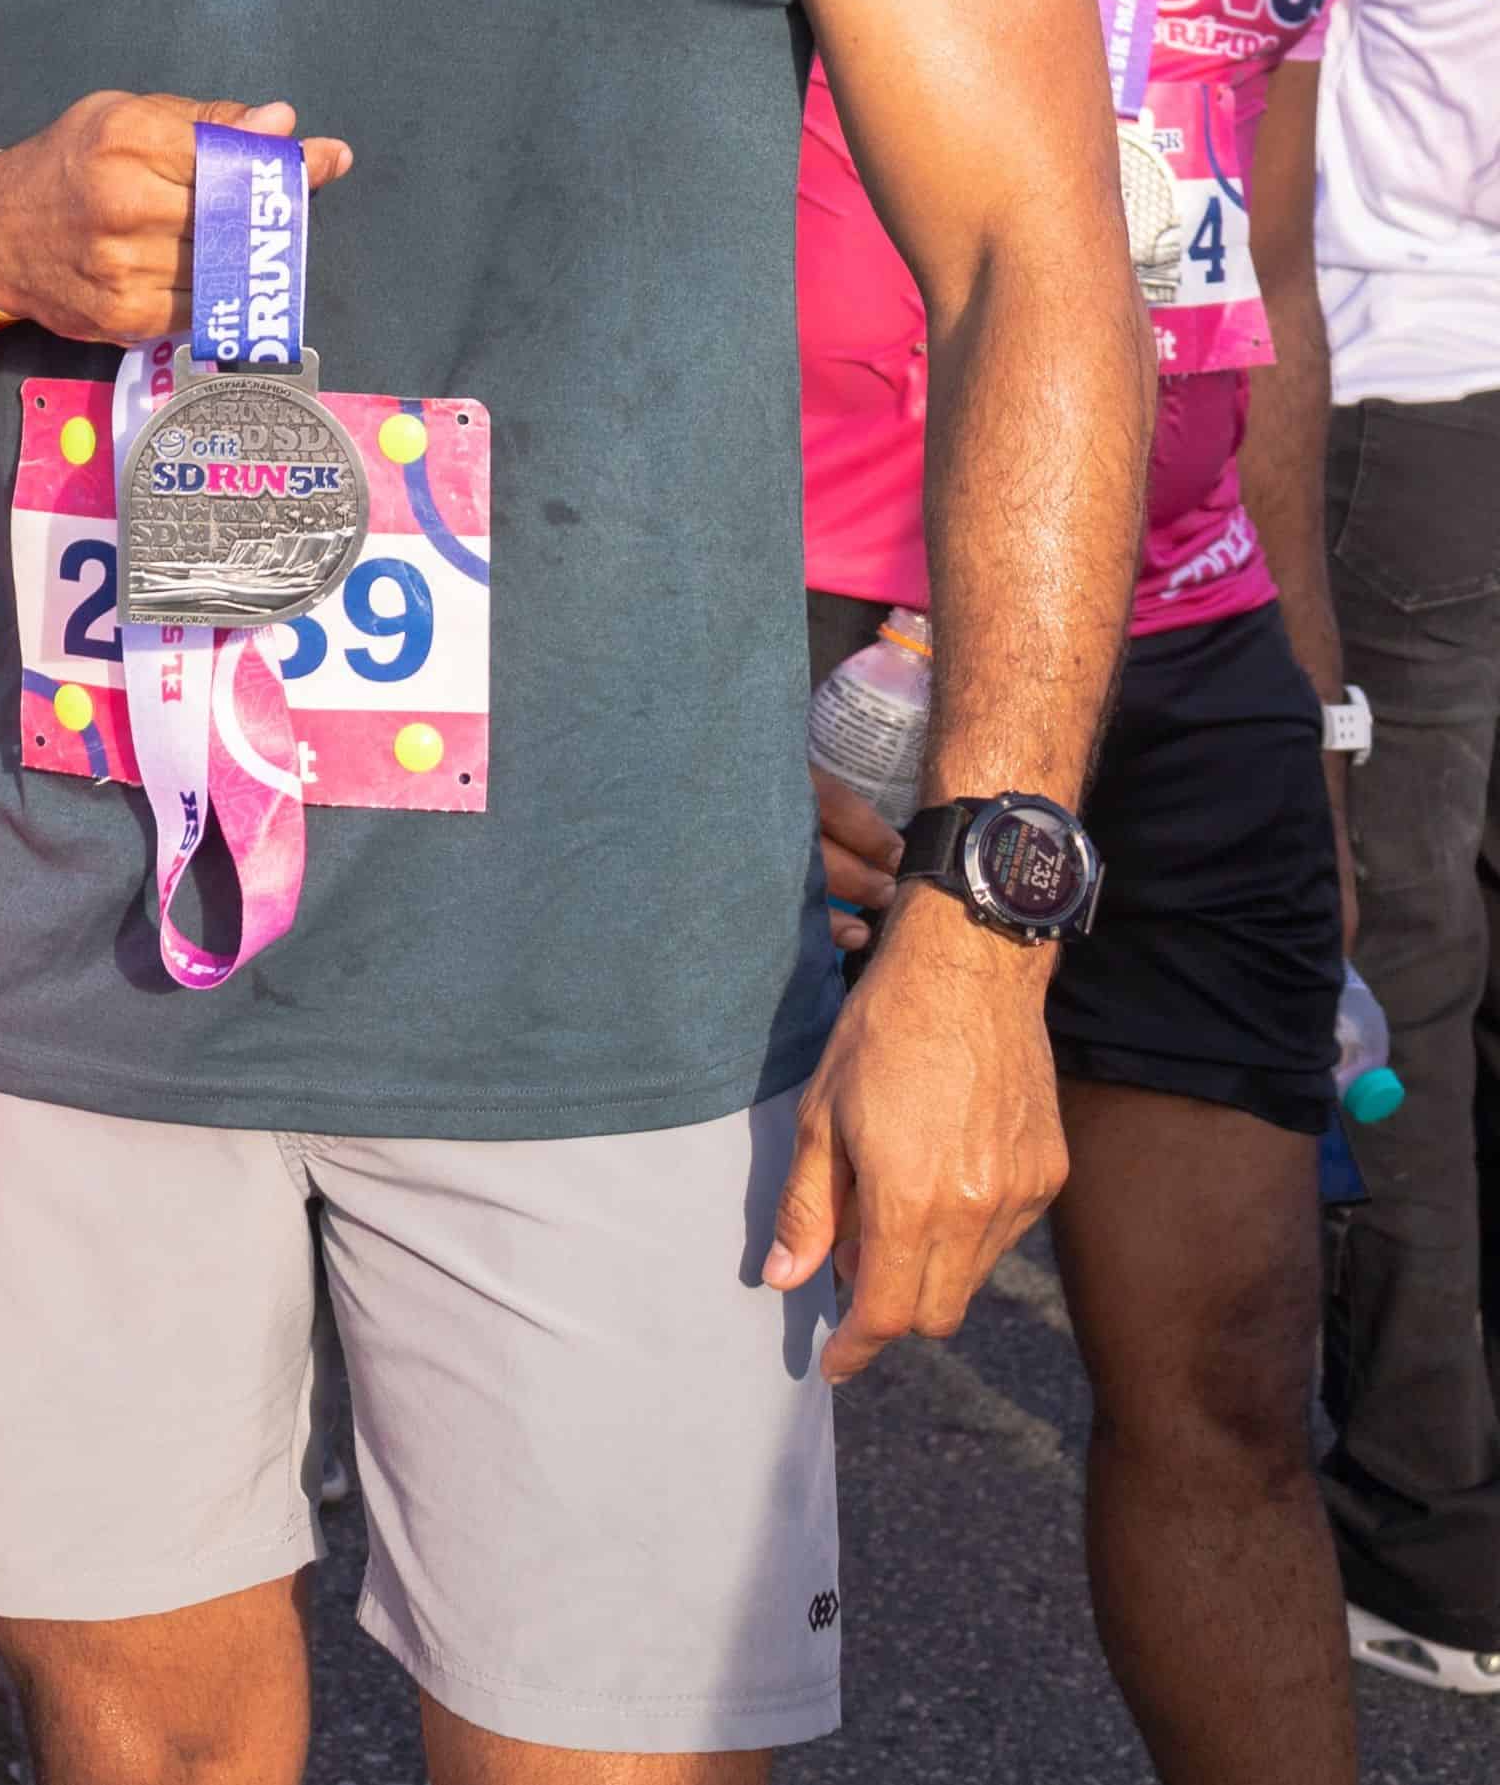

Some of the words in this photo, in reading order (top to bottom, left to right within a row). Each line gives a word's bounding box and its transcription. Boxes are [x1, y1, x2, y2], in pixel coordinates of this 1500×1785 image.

[206, 296, 241, 361] ofit
[192, 435, 240, 457] ofit
[1030, 850, 1056, 889] 7:33
